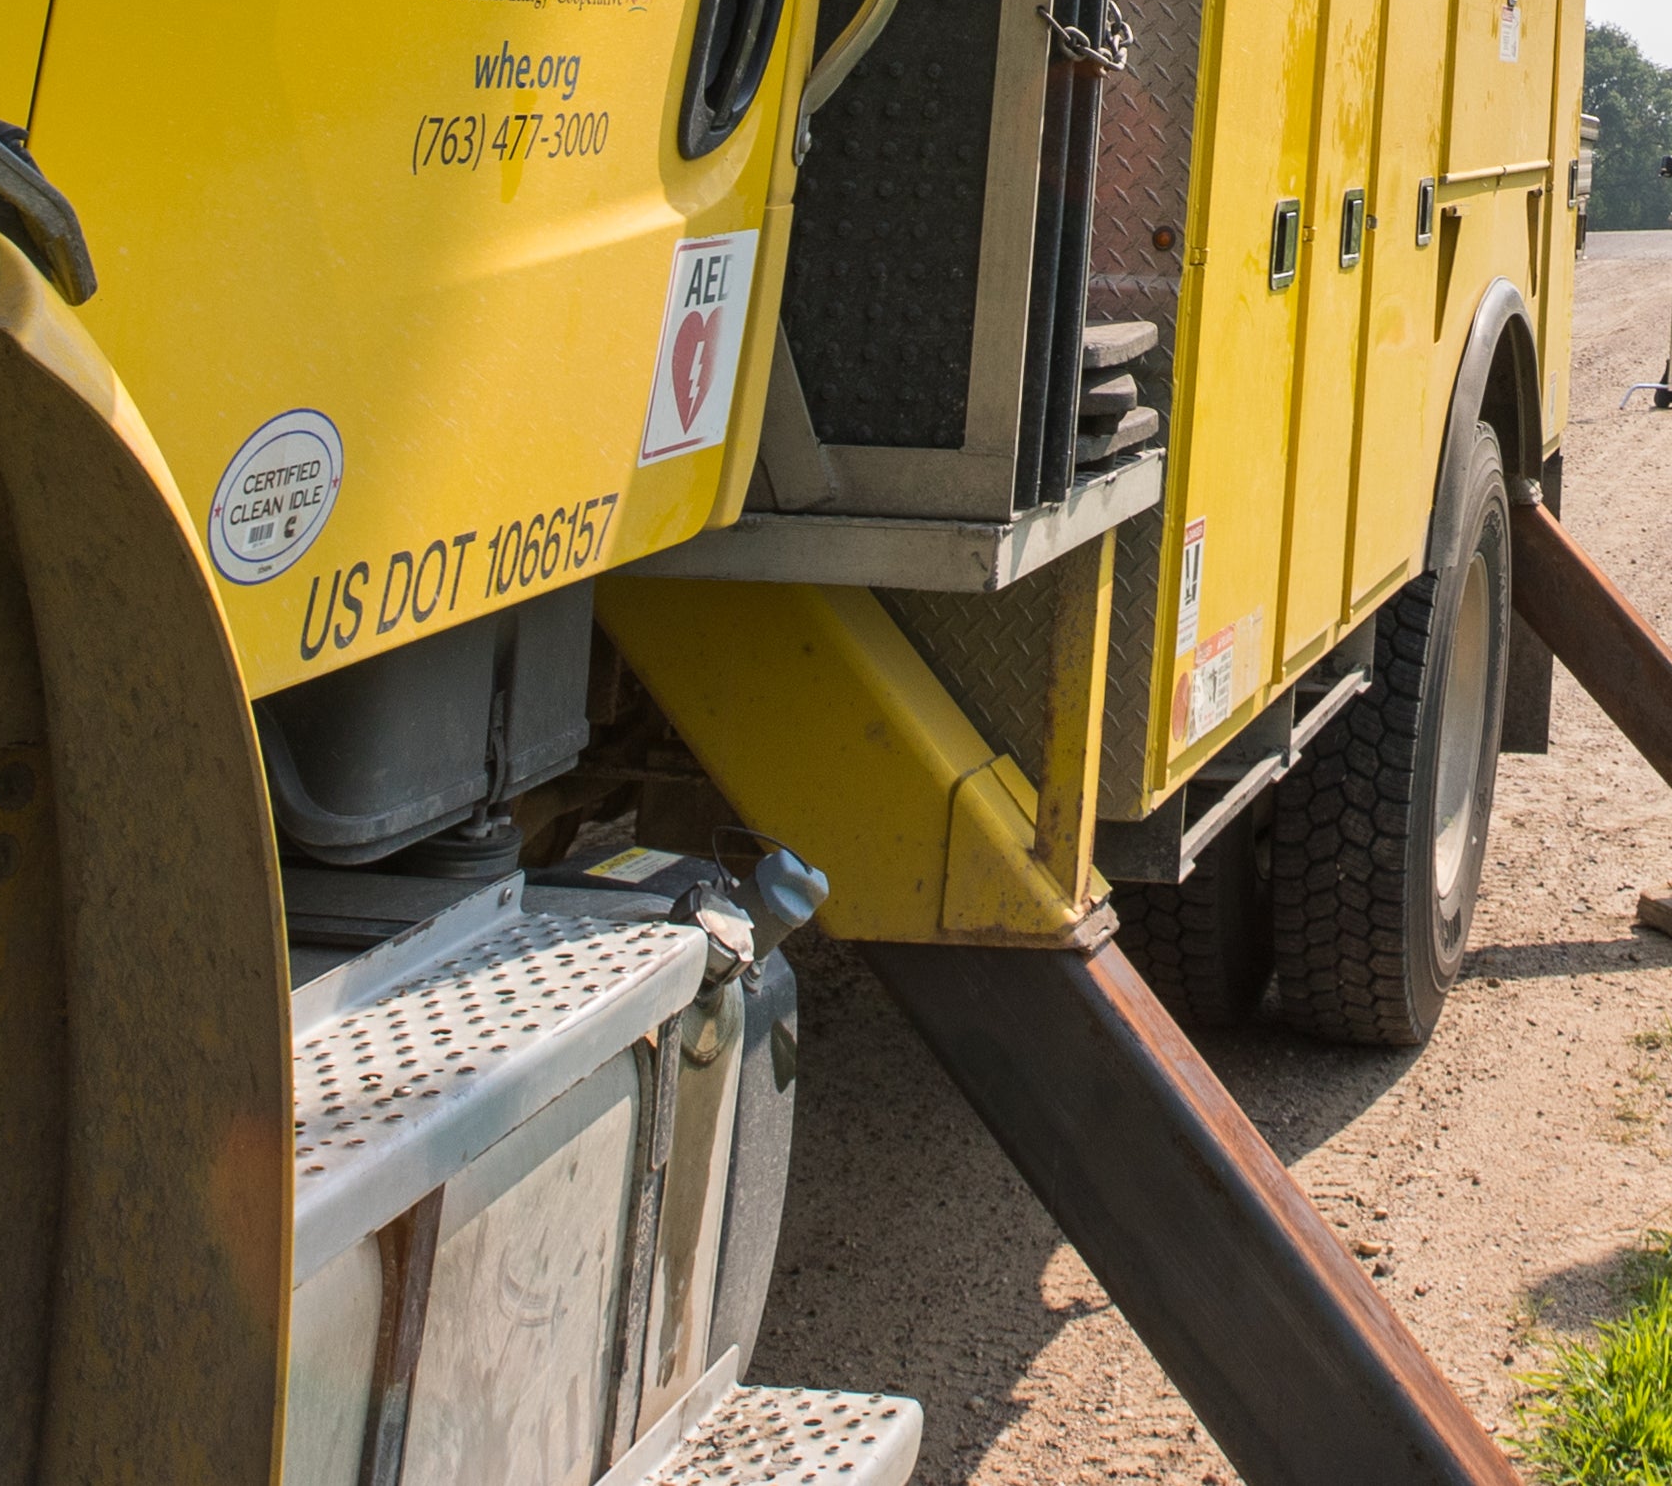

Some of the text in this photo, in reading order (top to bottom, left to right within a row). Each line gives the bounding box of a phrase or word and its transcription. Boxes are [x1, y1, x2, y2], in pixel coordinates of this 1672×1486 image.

[474, 40, 581, 101] whe.org
[412, 111, 610, 175] (763) 477-3000
[230, 485, 324, 525] CLEAN IDLE
[243, 460, 321, 494] CERTIFIED
[300, 493, 619, 661] US DOT 1066157
